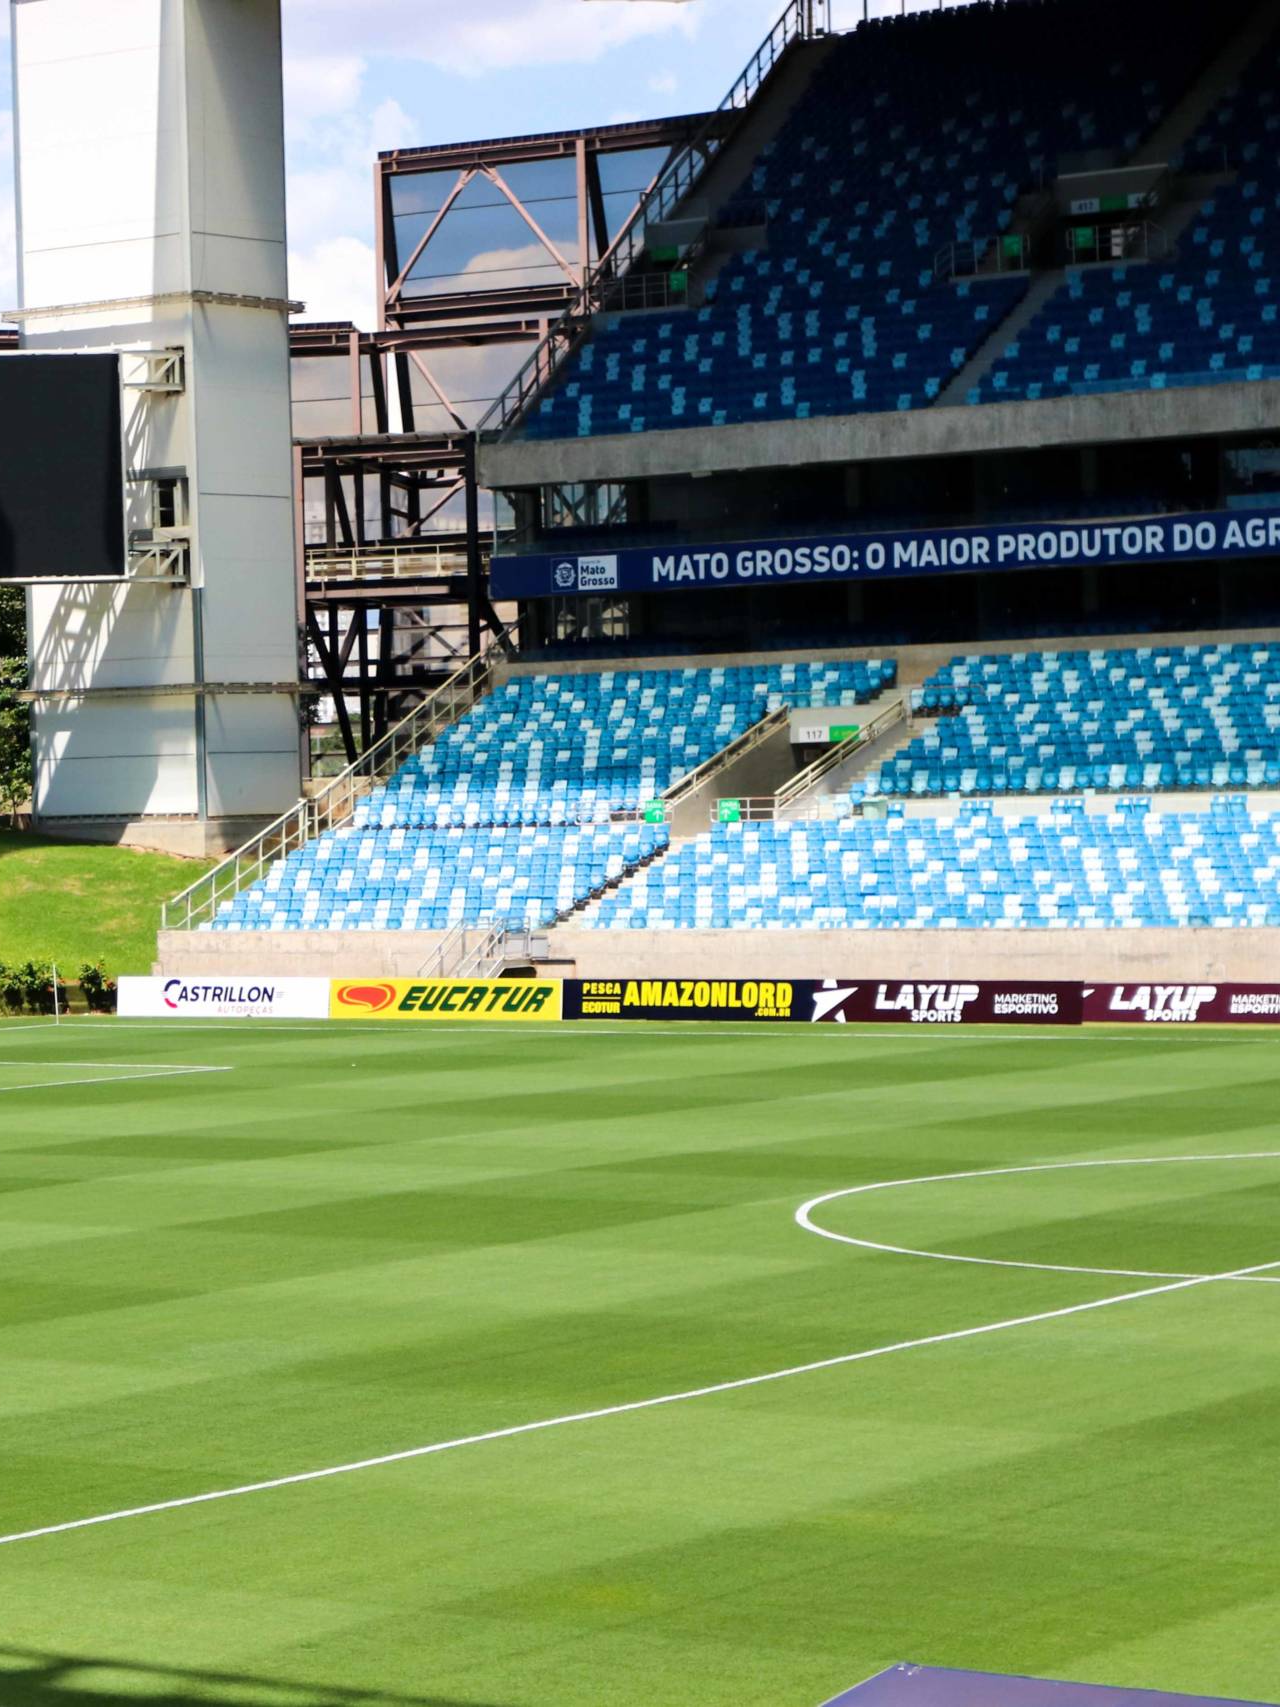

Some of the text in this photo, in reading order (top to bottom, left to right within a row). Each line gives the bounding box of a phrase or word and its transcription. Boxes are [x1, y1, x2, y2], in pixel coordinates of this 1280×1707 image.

[652, 552, 729, 582] MATO
[736, 545, 859, 577] GROSSO:
[866, 543, 886, 570] O
[893, 537, 991, 568] MAIOR
[997, 525, 1165, 562] PRODUTOR
[1173, 521, 1216, 551] DO
[580, 565, 606, 575] Mato
[580, 576, 615, 587] Grosso
[163, 979, 275, 1009] CASTRILLON
[582, 982, 621, 995] PESCA
[623, 981, 793, 1009] AMAZONLORD
[398, 986, 554, 1012] EUCATUR
[875, 984, 980, 1010] LAYUP
[993, 993, 1057, 1005] MARKETING
[1109, 986, 1217, 1010] LAYUP
[217, 1005, 274, 1015] AUTOPEÇAS
[582, 1002, 620, 1014] ECOTUR
[993, 1003, 1058, 1014] ESPORTIVO
[911, 1009, 962, 1022] SPORTS
[1144, 1009, 1198, 1021] SPORTS
